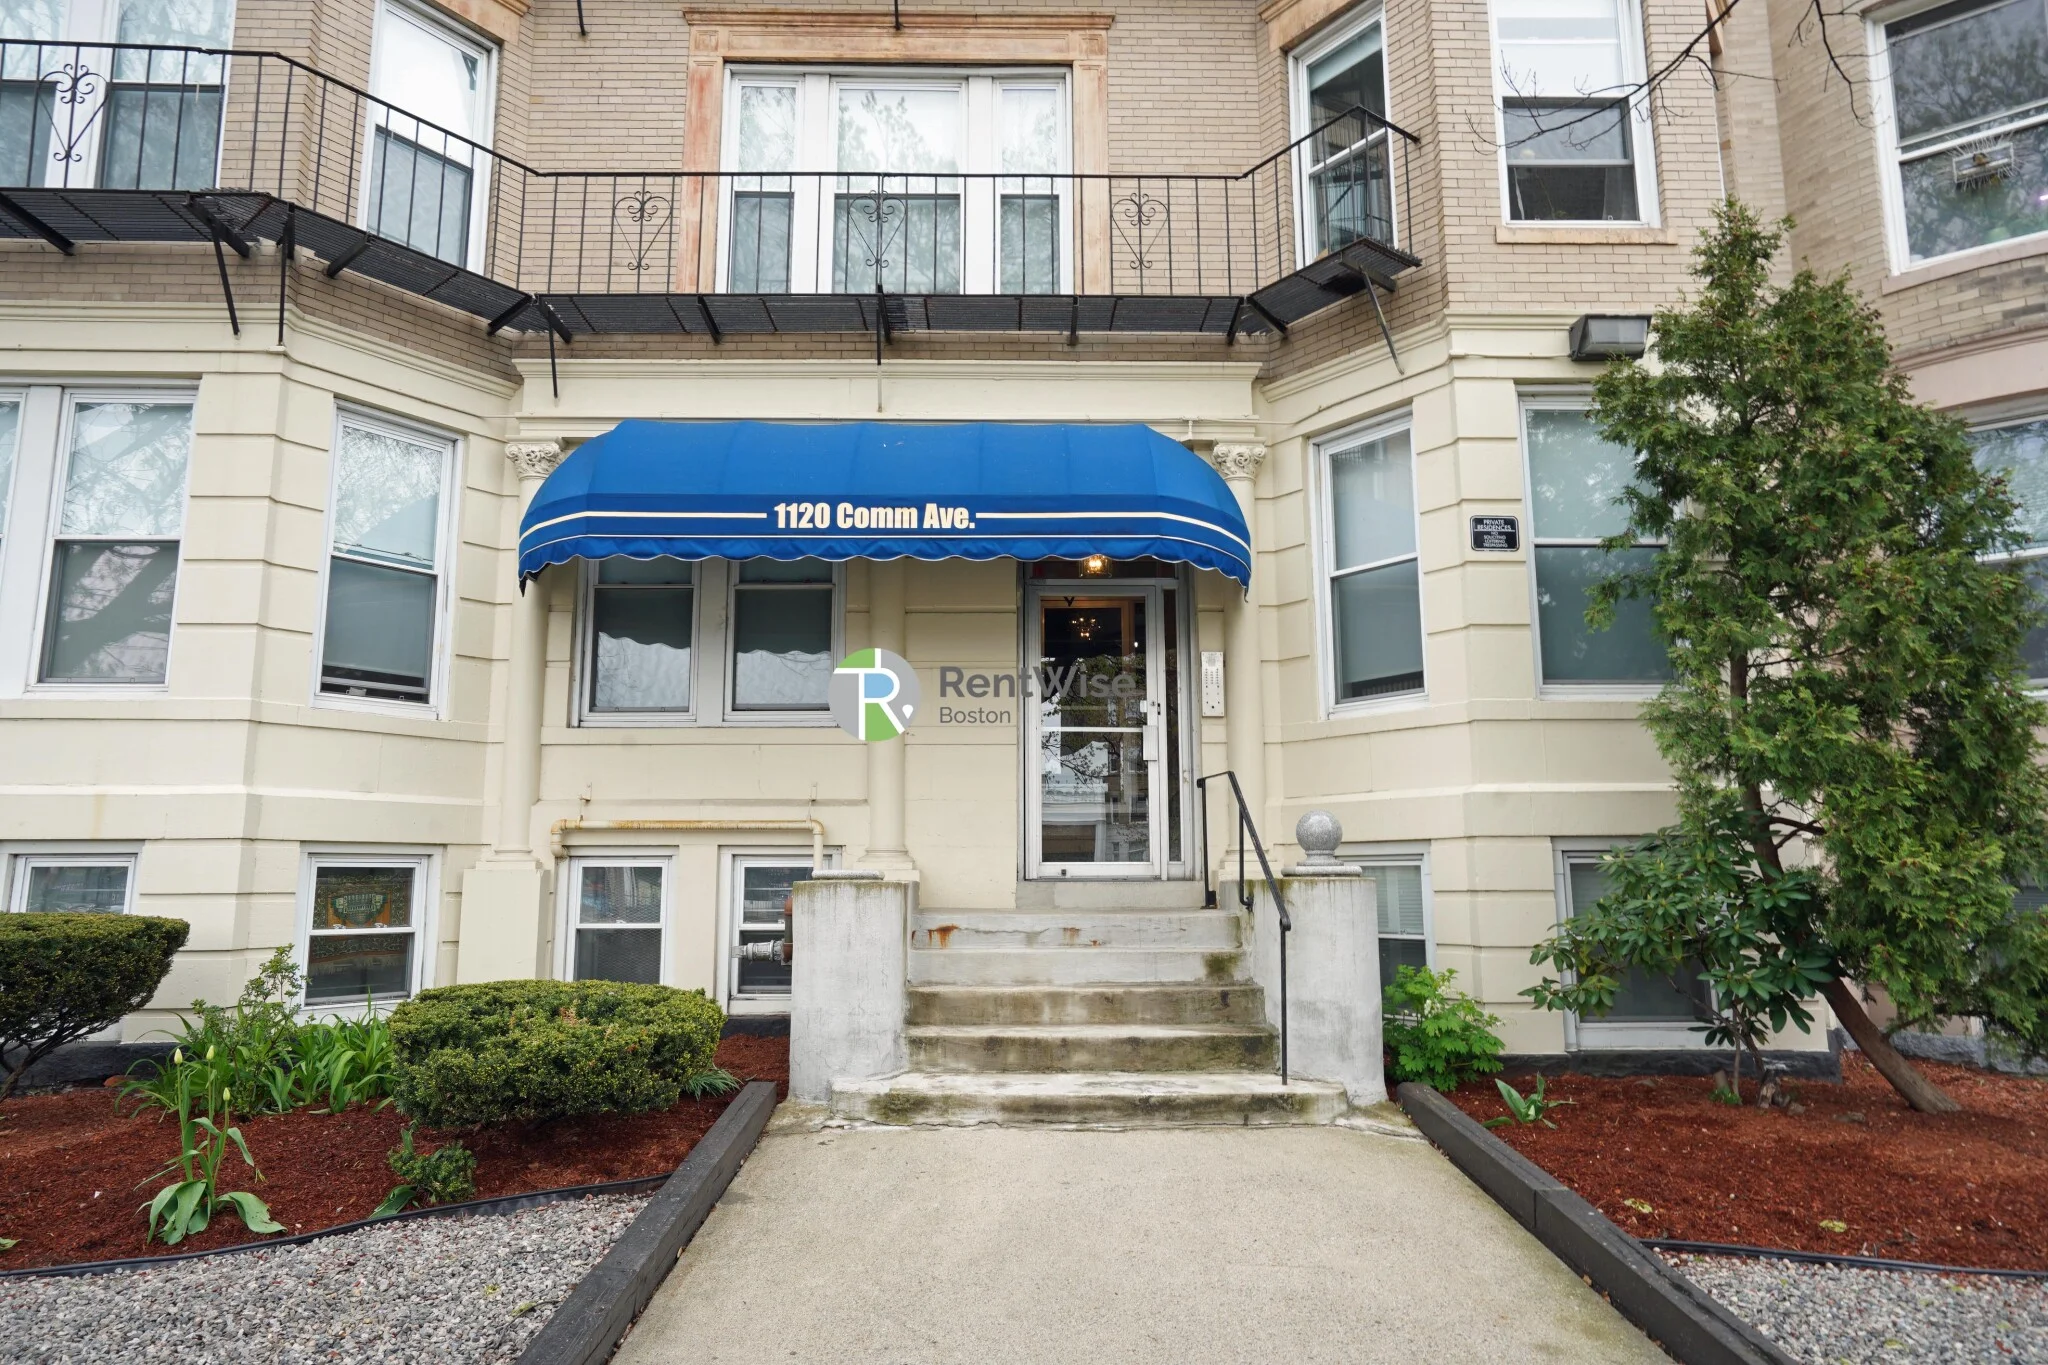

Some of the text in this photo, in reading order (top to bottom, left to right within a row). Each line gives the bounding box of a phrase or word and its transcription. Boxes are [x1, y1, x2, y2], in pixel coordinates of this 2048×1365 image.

[774, 502, 976, 529] 1120 Comm Ave.
